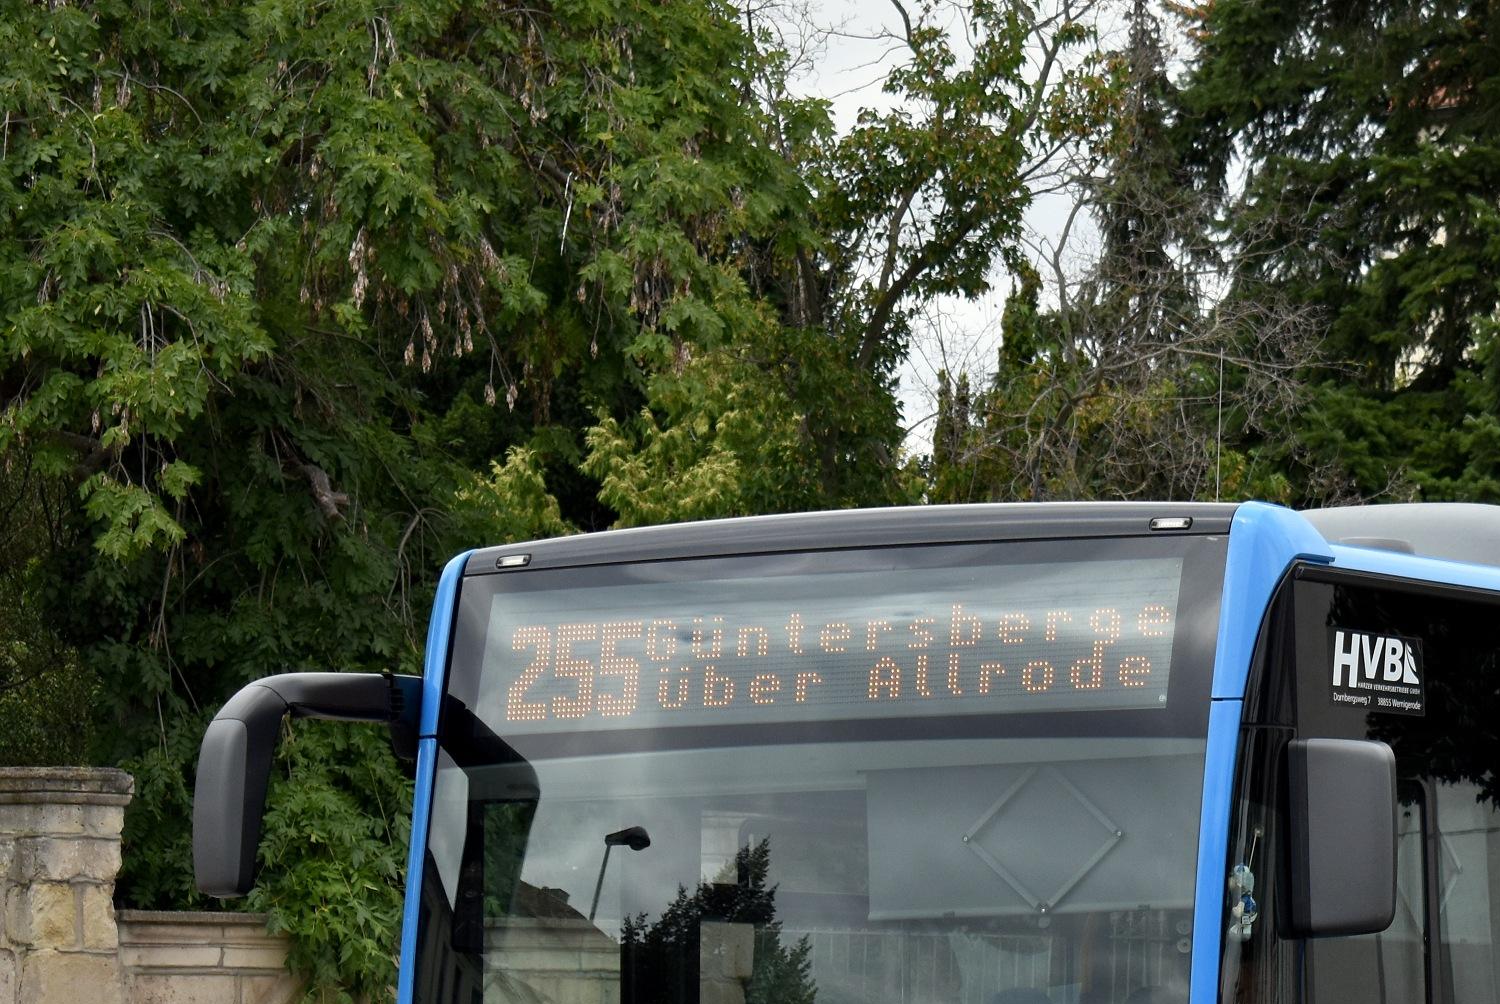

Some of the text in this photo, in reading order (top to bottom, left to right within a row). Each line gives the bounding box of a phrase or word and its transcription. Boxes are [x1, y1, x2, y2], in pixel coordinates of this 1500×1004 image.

[645, 604, 1171, 661] Güntersberge
[1332, 631, 1404, 688] HVB
[506, 620, 643, 721] 255
[657, 646, 1151, 709] über Allrode
